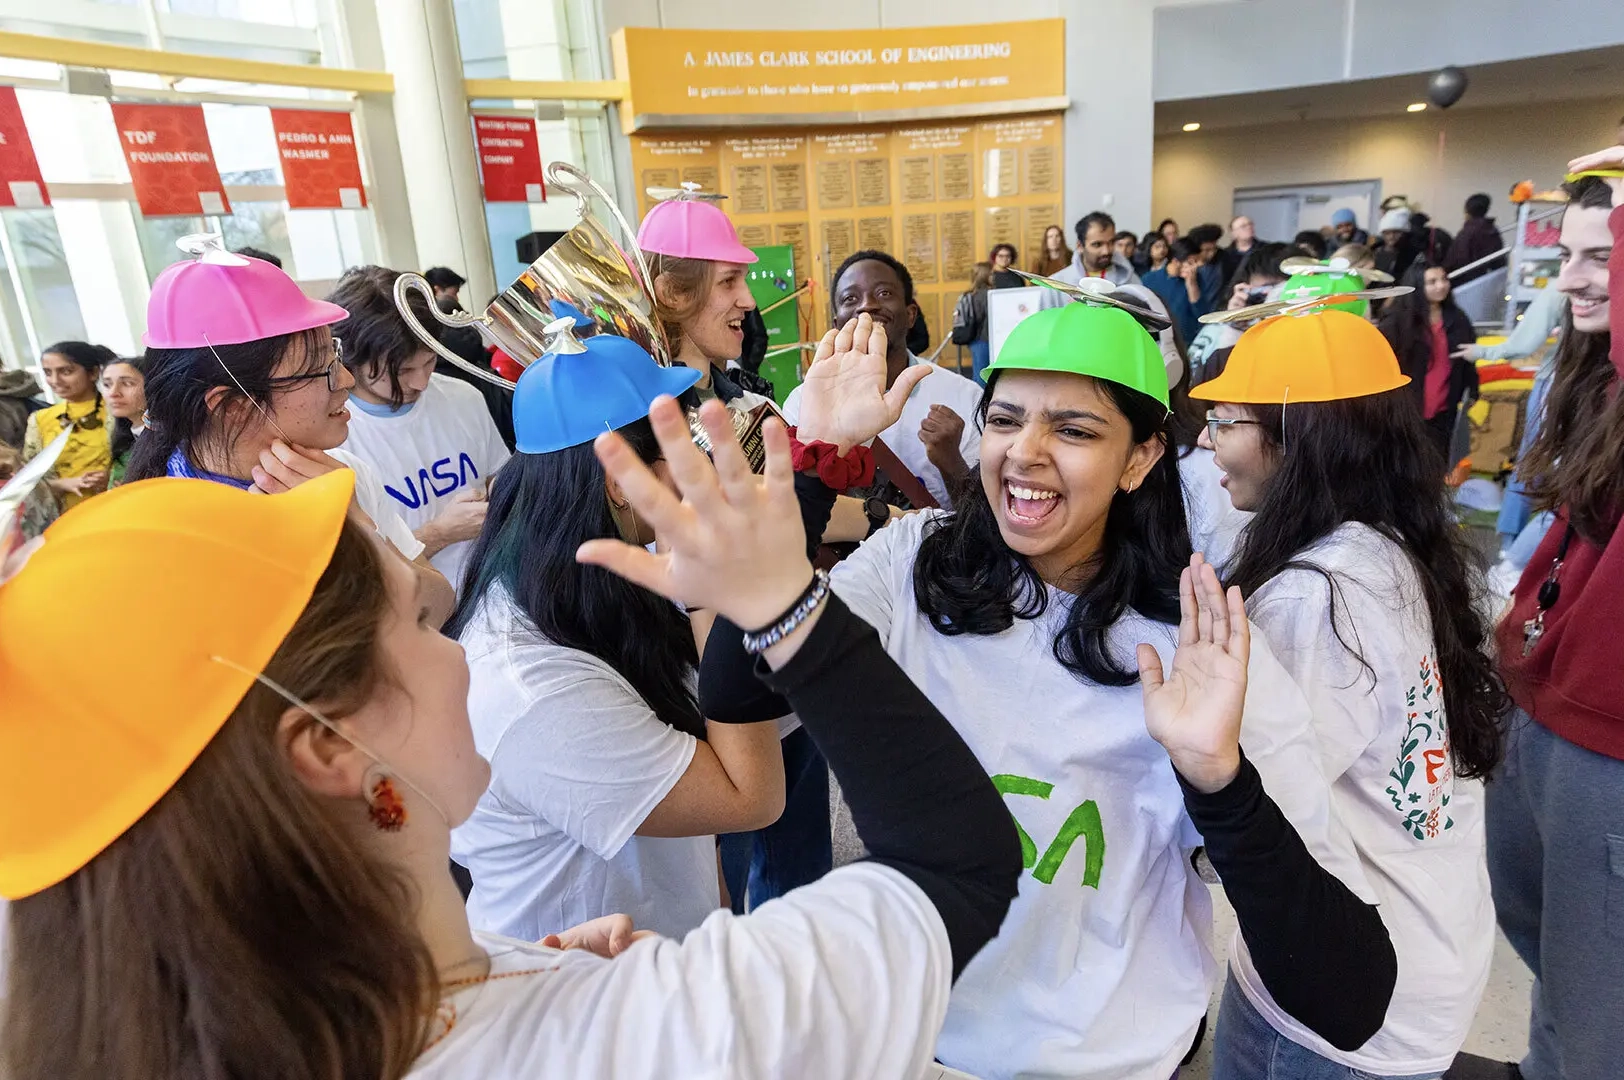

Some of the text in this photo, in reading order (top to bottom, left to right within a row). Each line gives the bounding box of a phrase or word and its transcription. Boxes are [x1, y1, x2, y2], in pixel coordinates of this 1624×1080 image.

[704, 51, 753, 67] JAMES
[758, 50, 809, 67] CLARK
[815, 48, 876, 66] SCHOOL
[880, 48, 902, 64] OF
[907, 41, 1010, 63] ENGINEERING
[123, 130, 157, 145] TDF
[278, 131, 353, 144] PEDRO & ANN
[129, 151, 209, 163] FOUNDATION
[484, 155, 514, 166] COMPANY
[743, 434, 760, 457] UMNI
[384, 452, 478, 510] NASA
[990, 774, 1106, 890] SA
